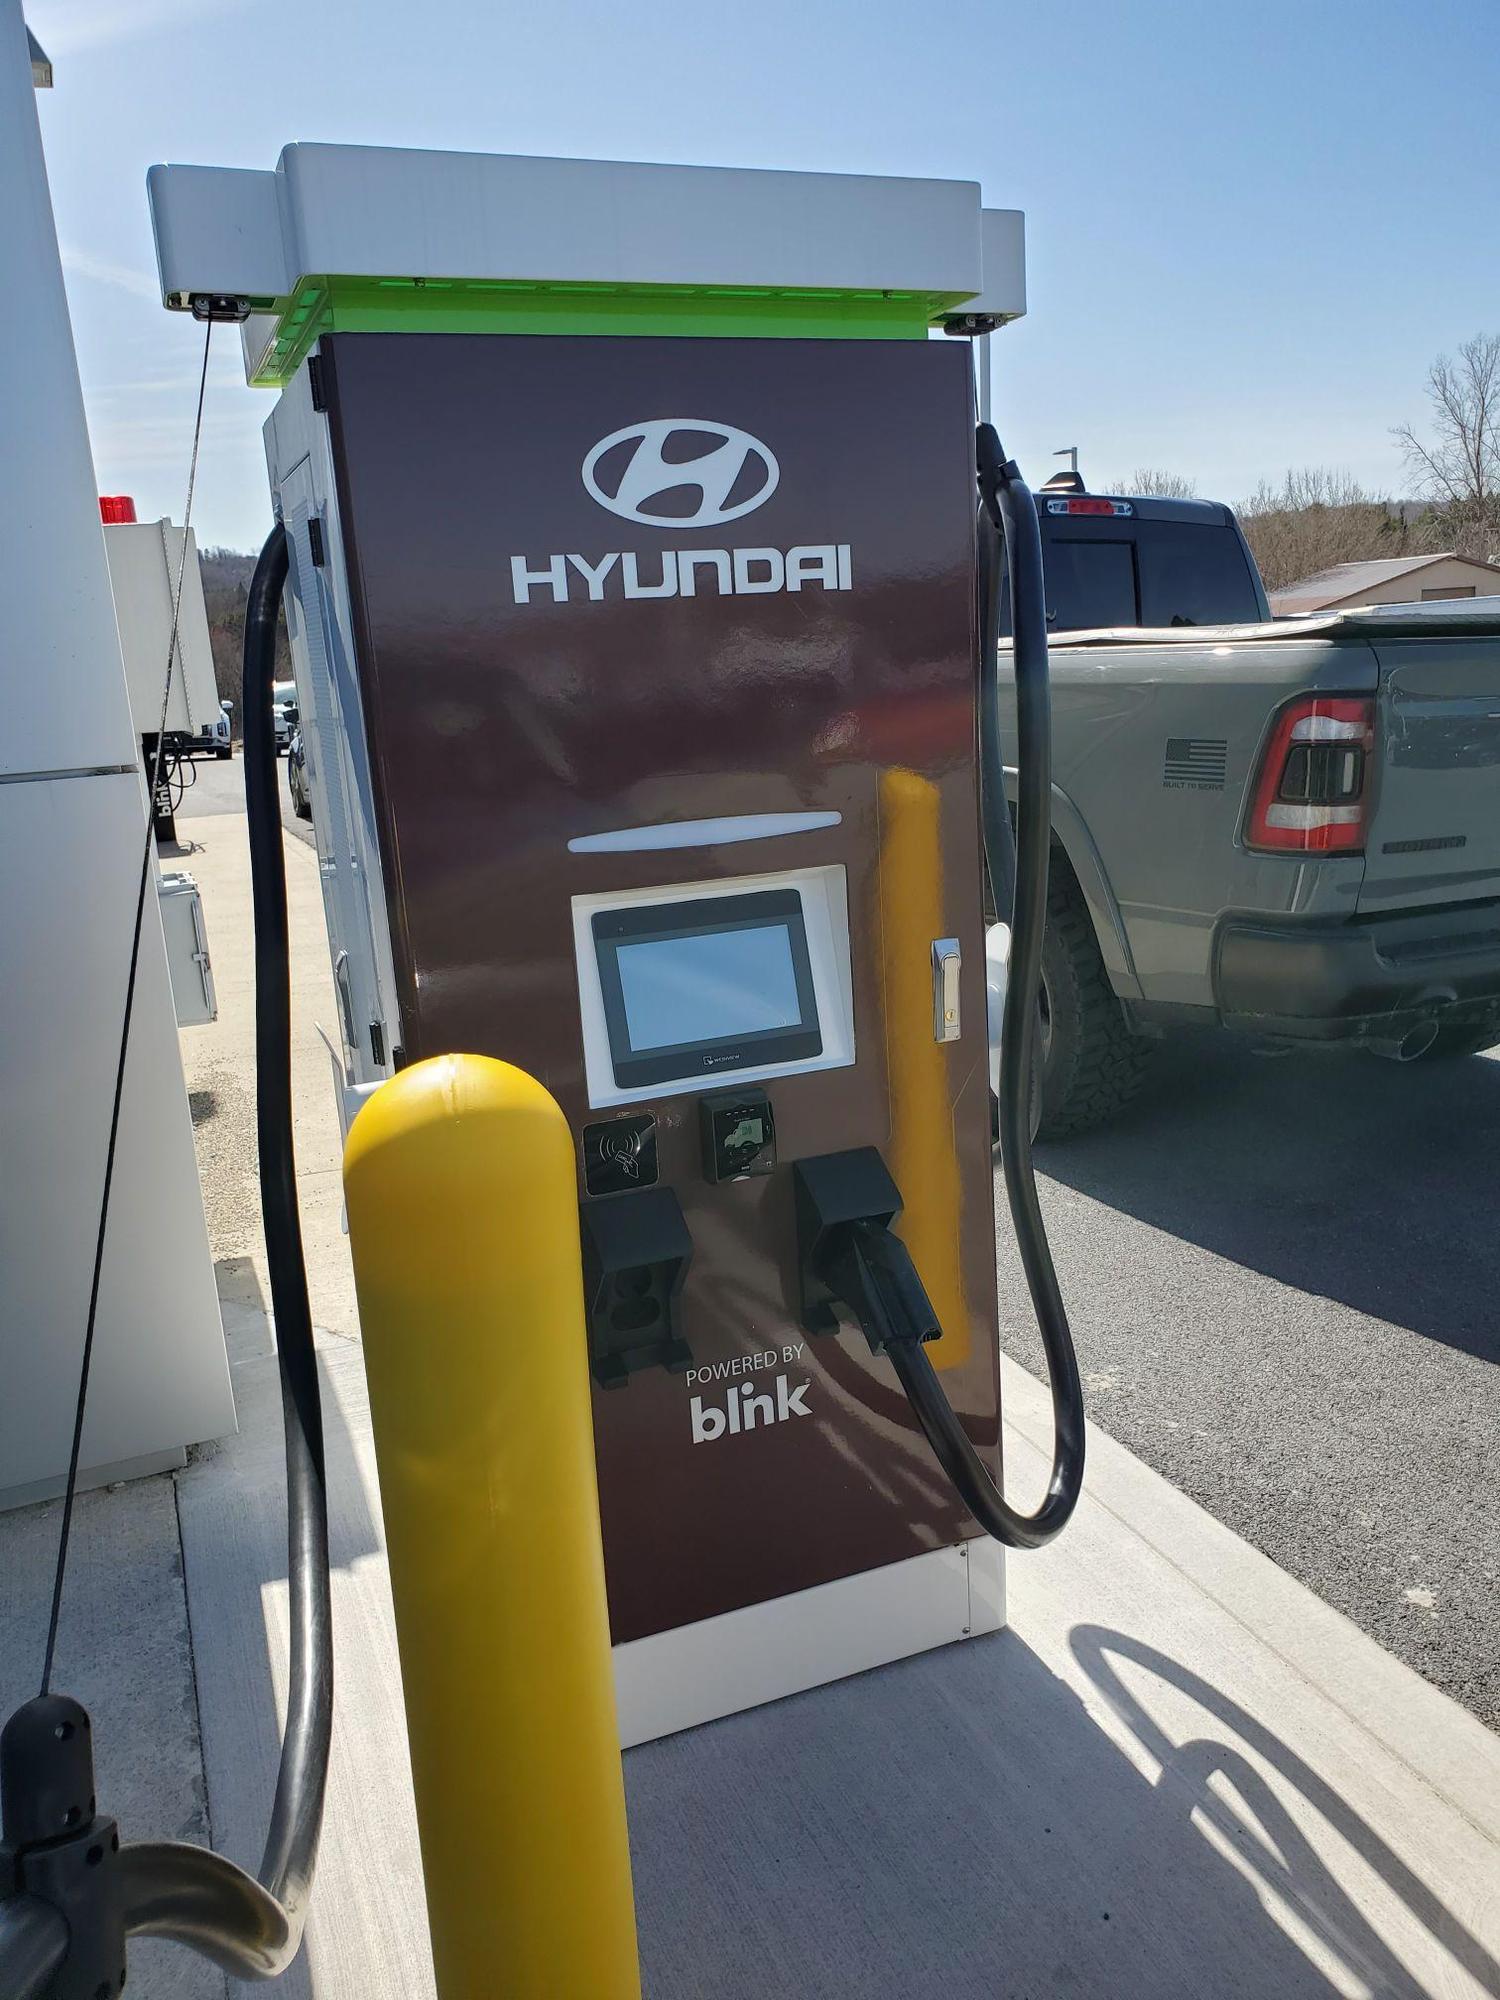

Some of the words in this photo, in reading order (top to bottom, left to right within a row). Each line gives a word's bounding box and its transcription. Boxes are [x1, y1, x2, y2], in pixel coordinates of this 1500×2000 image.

[510, 544, 853, 604] HYUNDAI
[686, 1350, 778, 1387] POWERED
[782, 1342, 805, 1363] BY
[690, 1374, 813, 1444] blink
